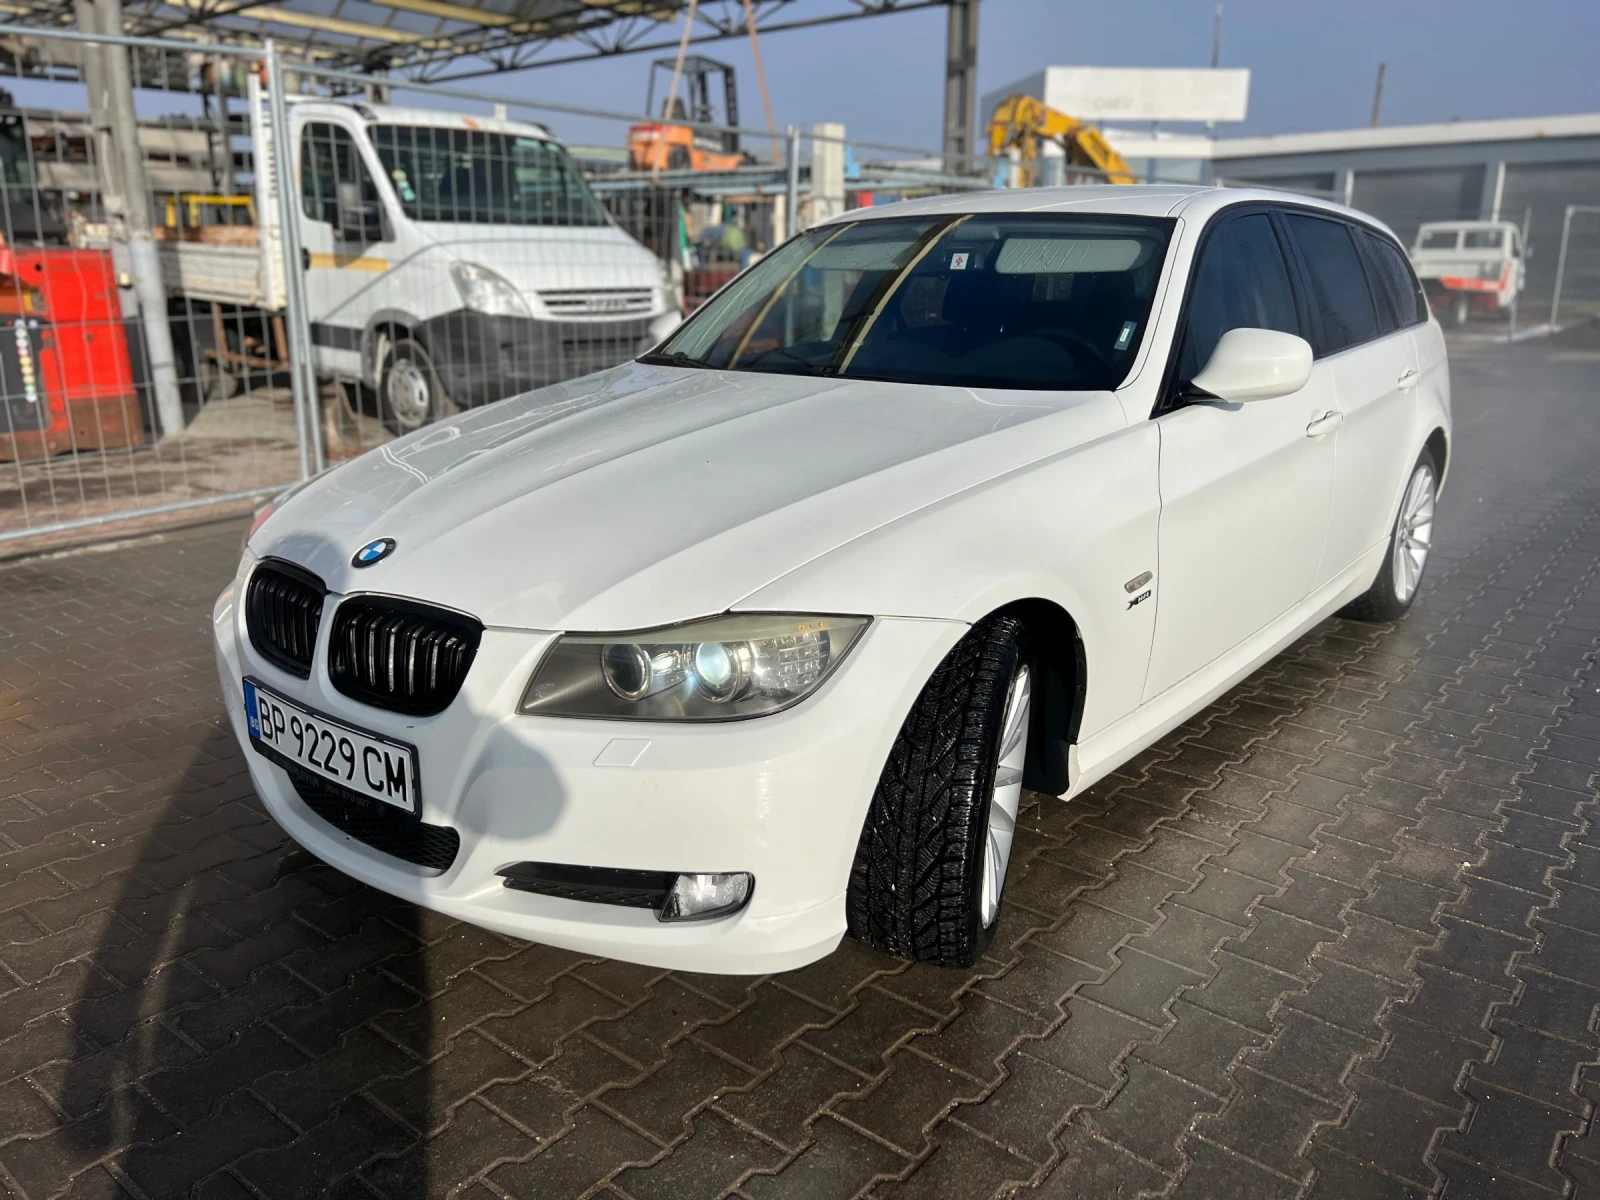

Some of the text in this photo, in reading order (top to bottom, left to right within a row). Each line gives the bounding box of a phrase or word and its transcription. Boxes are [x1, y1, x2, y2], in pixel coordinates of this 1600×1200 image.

[250, 715, 260, 731] BG
[257, 696, 407, 803] BP 9229 CM
